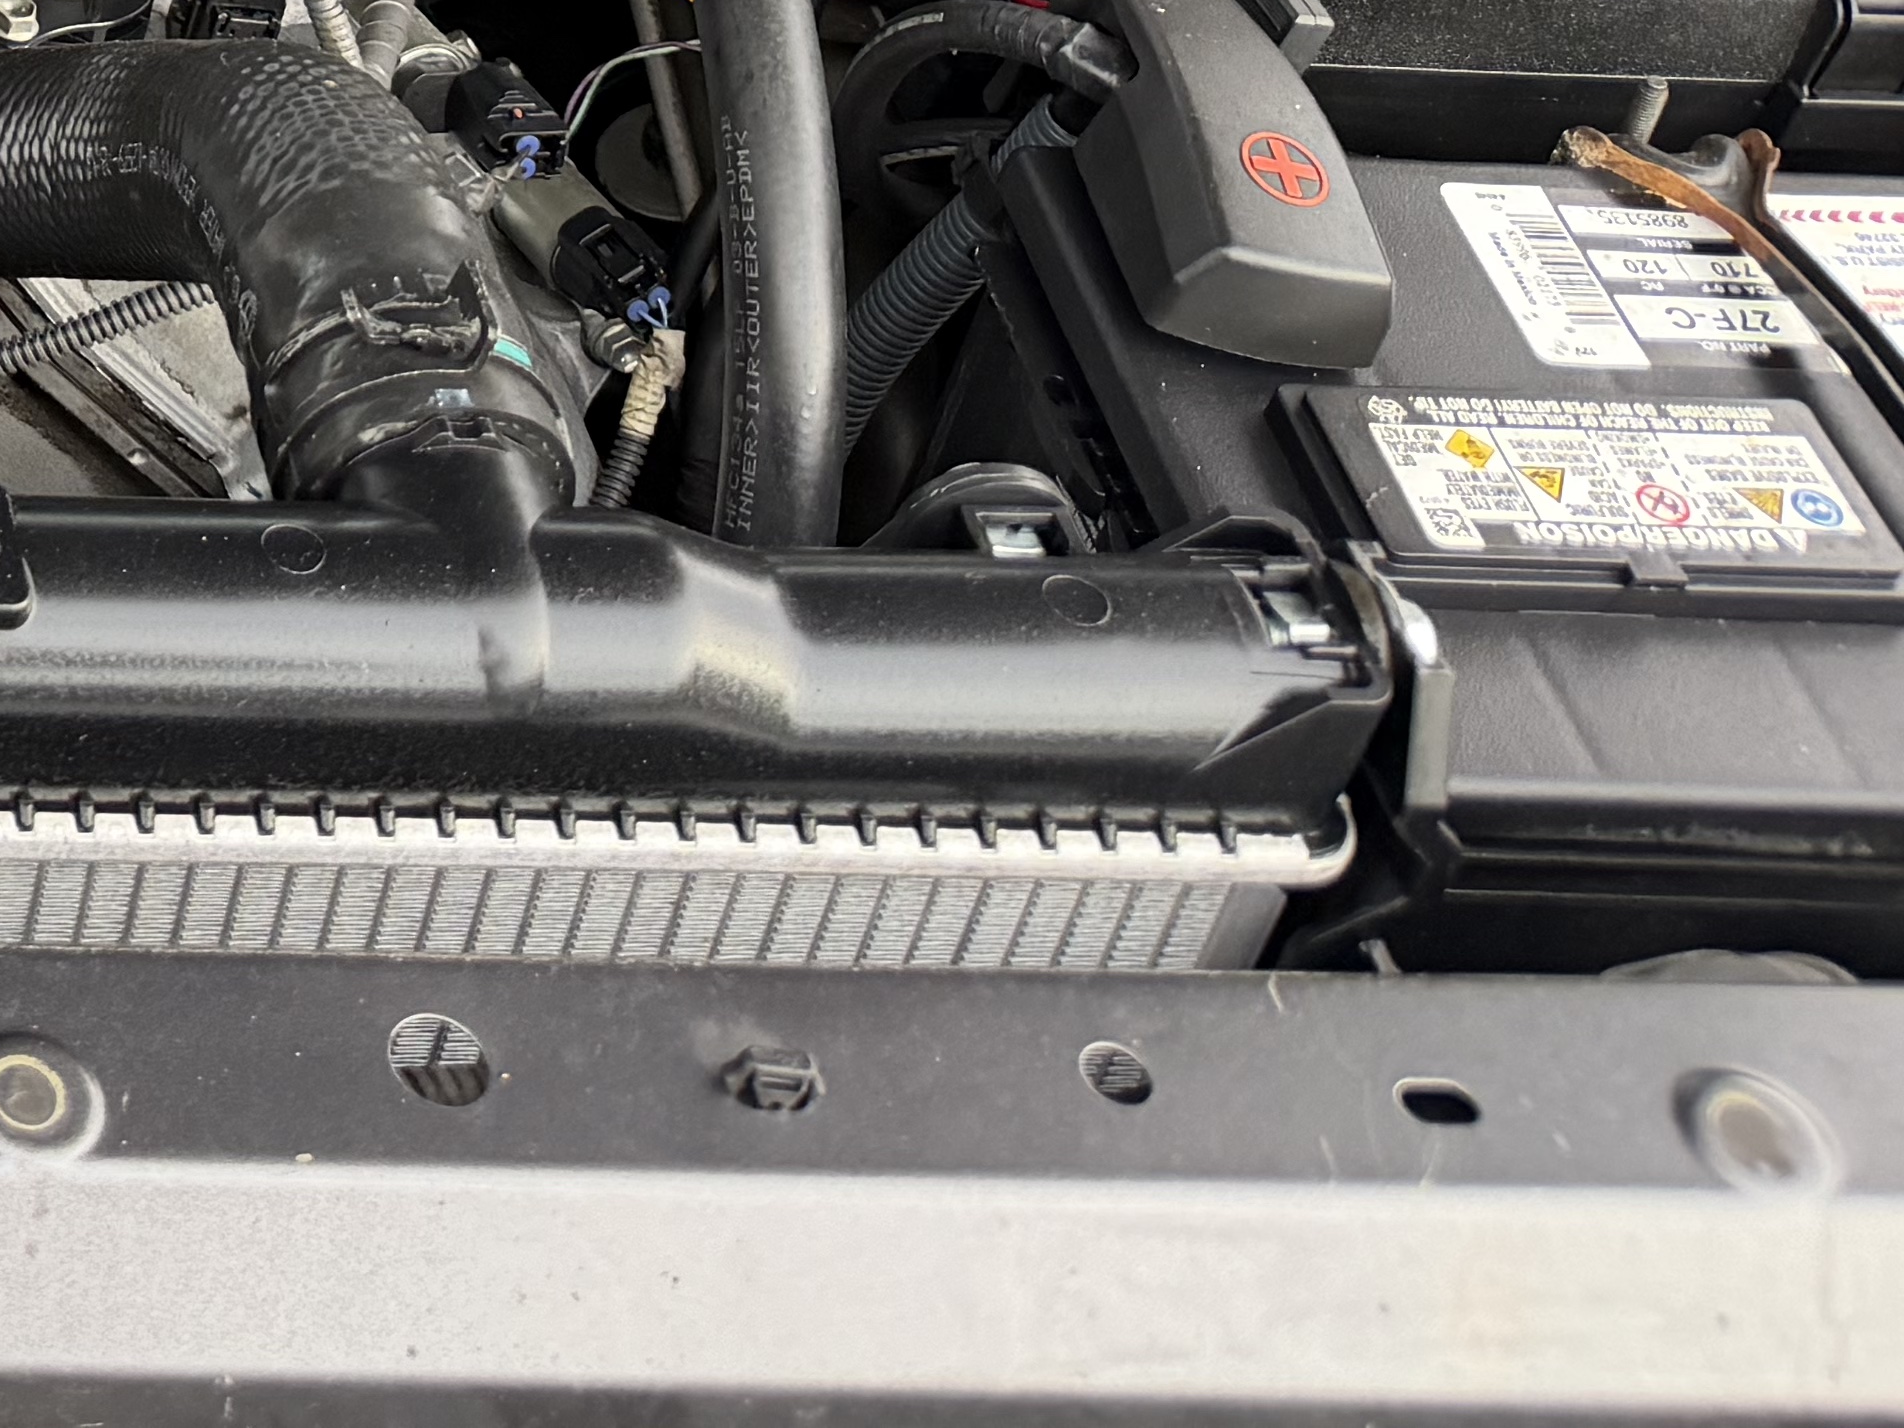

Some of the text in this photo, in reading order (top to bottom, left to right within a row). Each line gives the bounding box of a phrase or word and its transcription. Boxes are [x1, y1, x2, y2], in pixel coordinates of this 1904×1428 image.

[1635, 237, 1692, 249] SERIAL
[1622, 258, 1668, 275] 120
[1710, 262, 1760, 278] 710
[1665, 307, 1780, 333] 27F-C
[1729, 341, 1771, 354] PART
[1439, 397, 1470, 410] NOT
[1470, 398, 1493, 411] DO
[1561, 401, 1603, 415] OPEN
[1603, 402, 1633, 416] NOT
[1633, 403, 1658, 417] DO
[1426, 410, 1456, 423] ALL
[1457, 411, 1497, 424] READ
[1580, 415, 1599, 428] OF
[1679, 418, 1699, 431] OF
[1699, 419, 1731, 431] OUT
[1412, 429, 1443, 441] HELP
[1445, 483, 1522, 497] IMMEDIATELY
[1461, 497, 1492, 510] EYES
